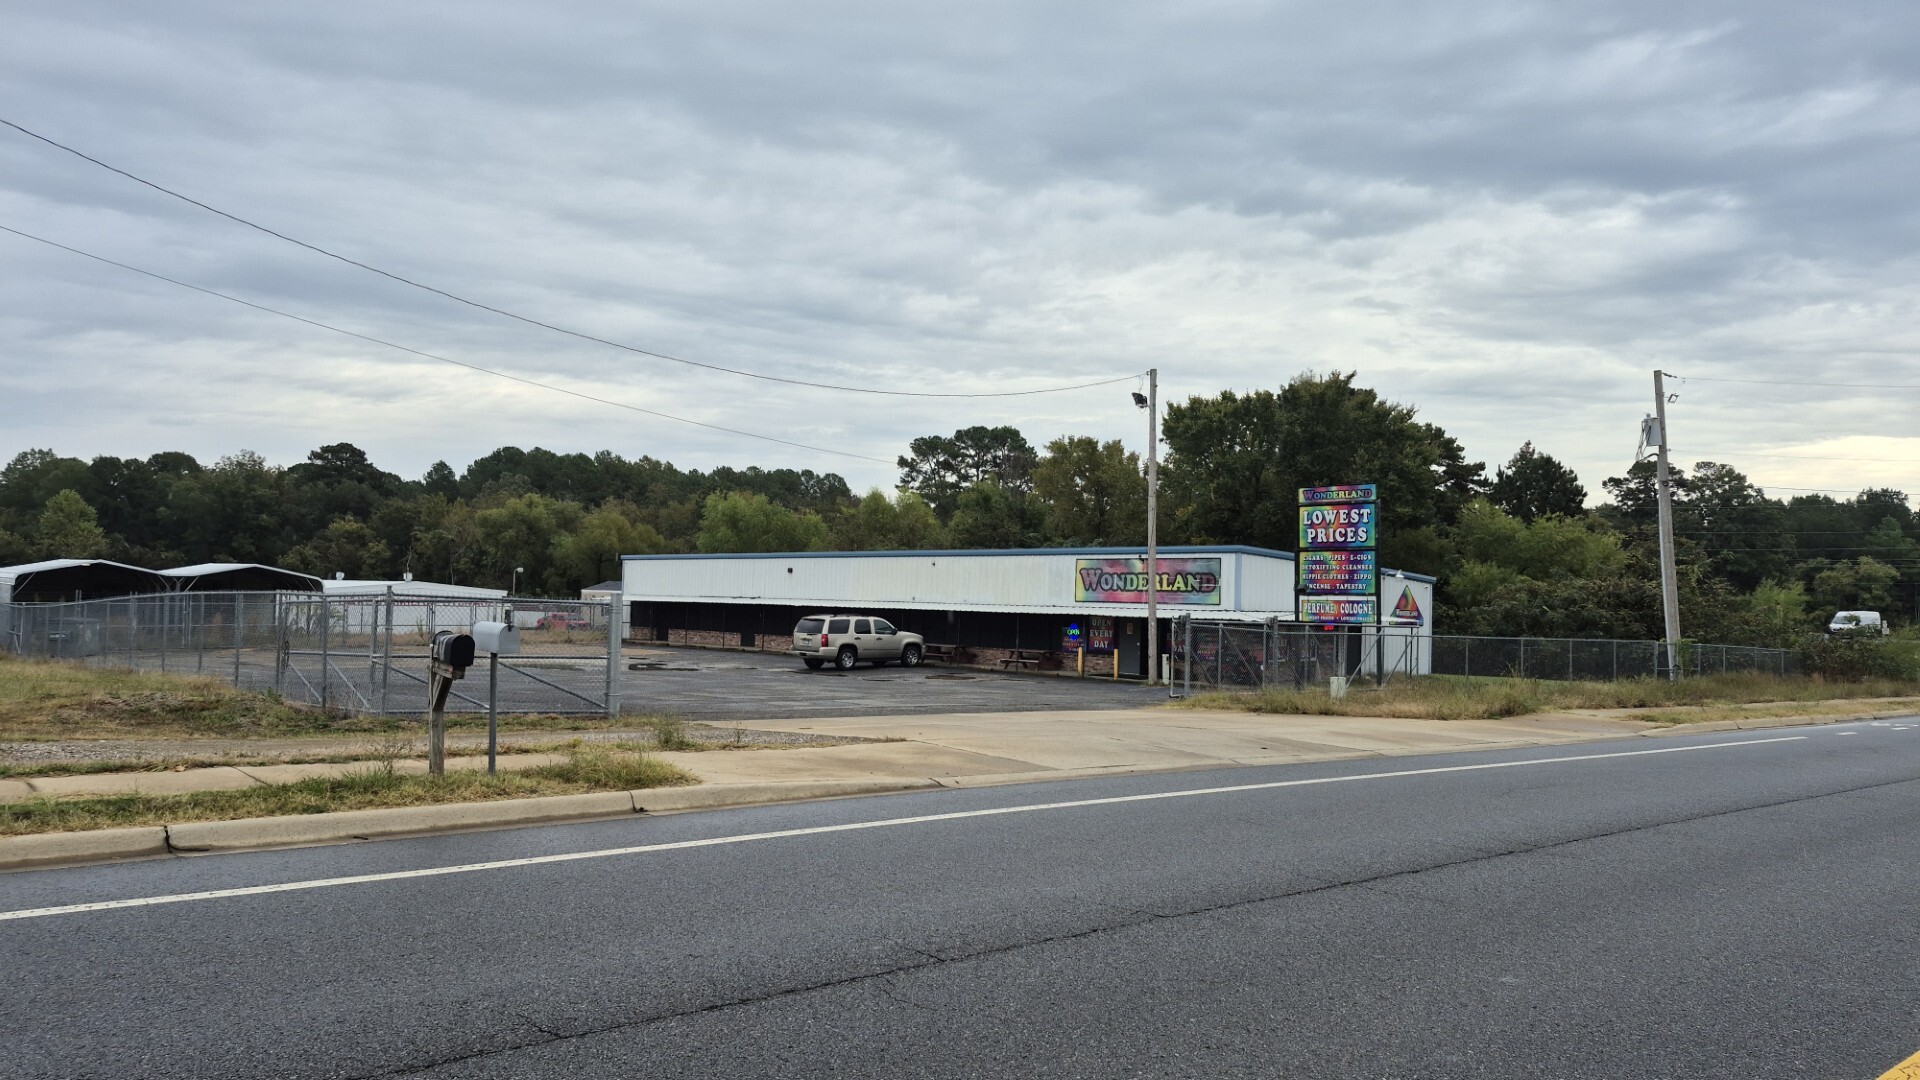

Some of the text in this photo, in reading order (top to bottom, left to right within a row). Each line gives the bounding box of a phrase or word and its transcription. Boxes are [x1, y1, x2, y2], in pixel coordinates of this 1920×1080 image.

[1303, 488, 1373, 500] WONDERLAND
[1303, 508, 1371, 525] LOWEST
[1307, 527, 1367, 543] PRICES
[1304, 603, 1334, 614] PERFUME
[1340, 603, 1373, 614] COLOGNE
[1092, 618, 1112, 626] OPEN
[1089, 629, 1114, 638] EVERY
[1094, 640, 1109, 648] DAY
